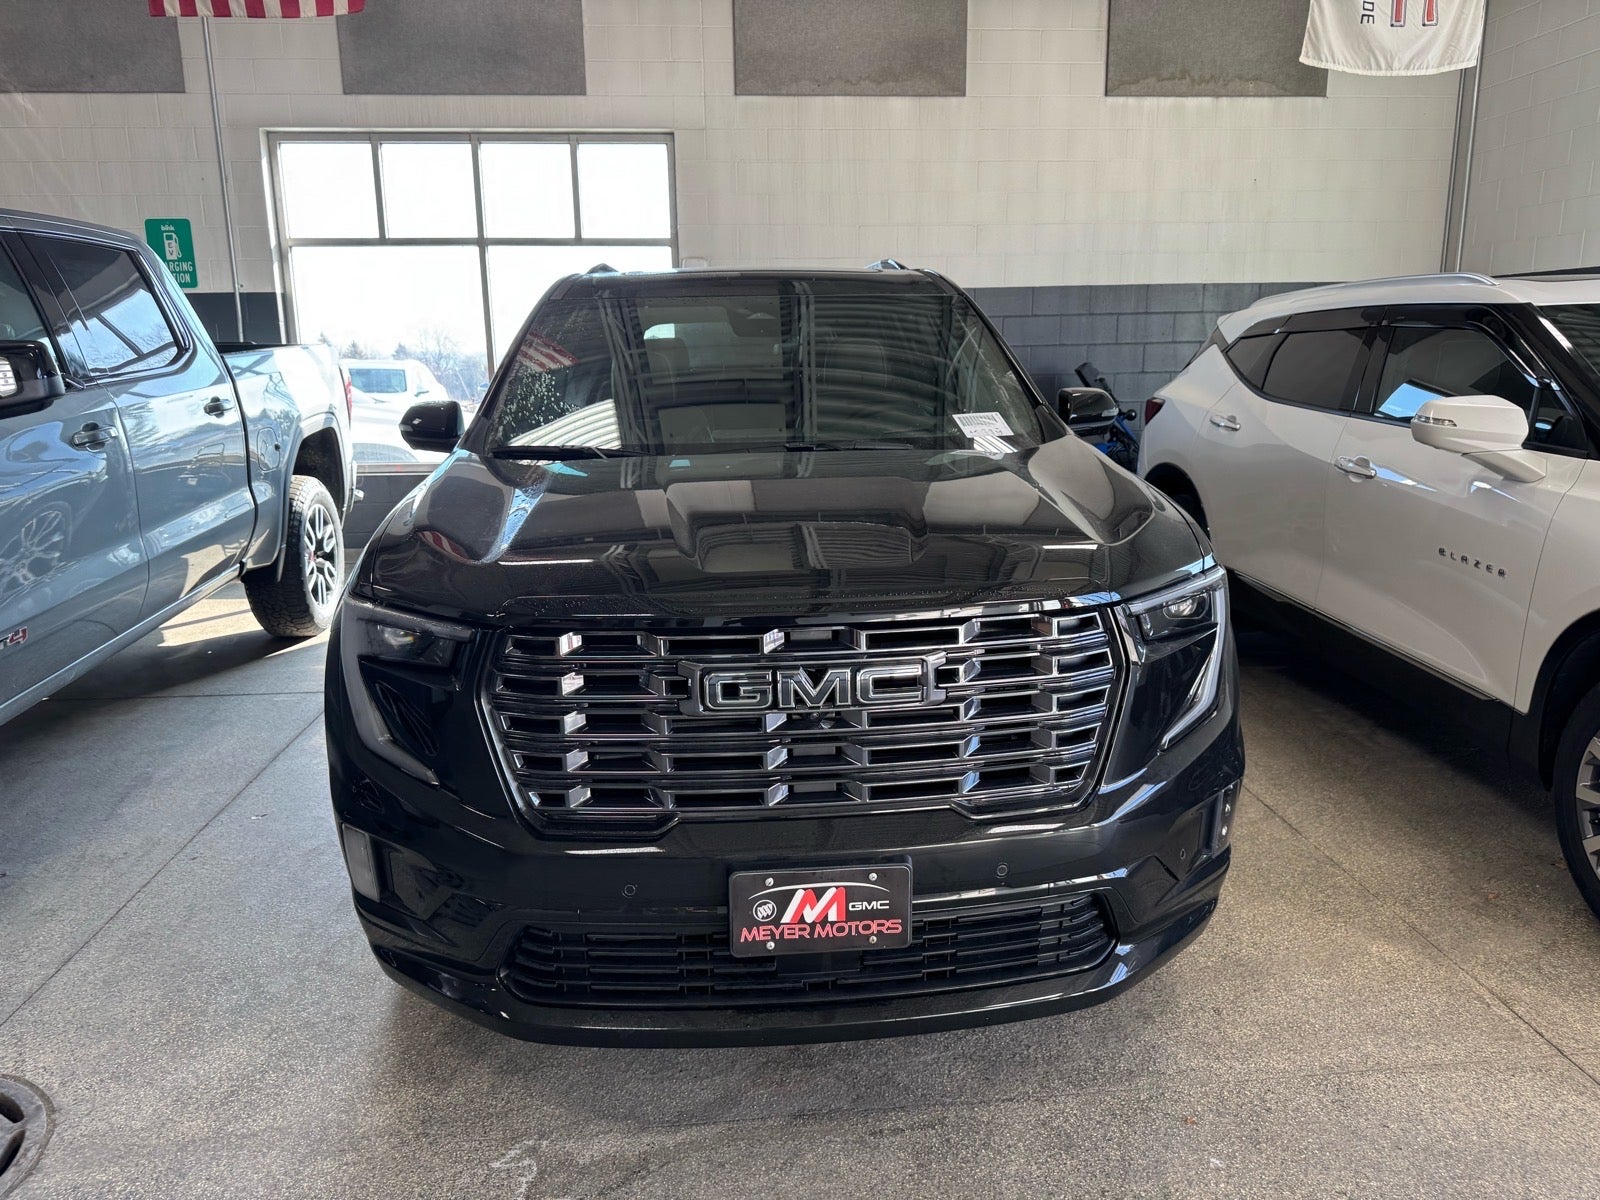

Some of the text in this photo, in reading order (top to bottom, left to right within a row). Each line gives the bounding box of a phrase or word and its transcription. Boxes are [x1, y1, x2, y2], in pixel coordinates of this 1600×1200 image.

[165, 261, 193, 272] RGING
[1438, 547, 1506, 579] BLAZER
[704, 664, 923, 710] GMC
[848, 900, 890, 911] GMC
[740, 919, 903, 943] MEYER MOTORS
